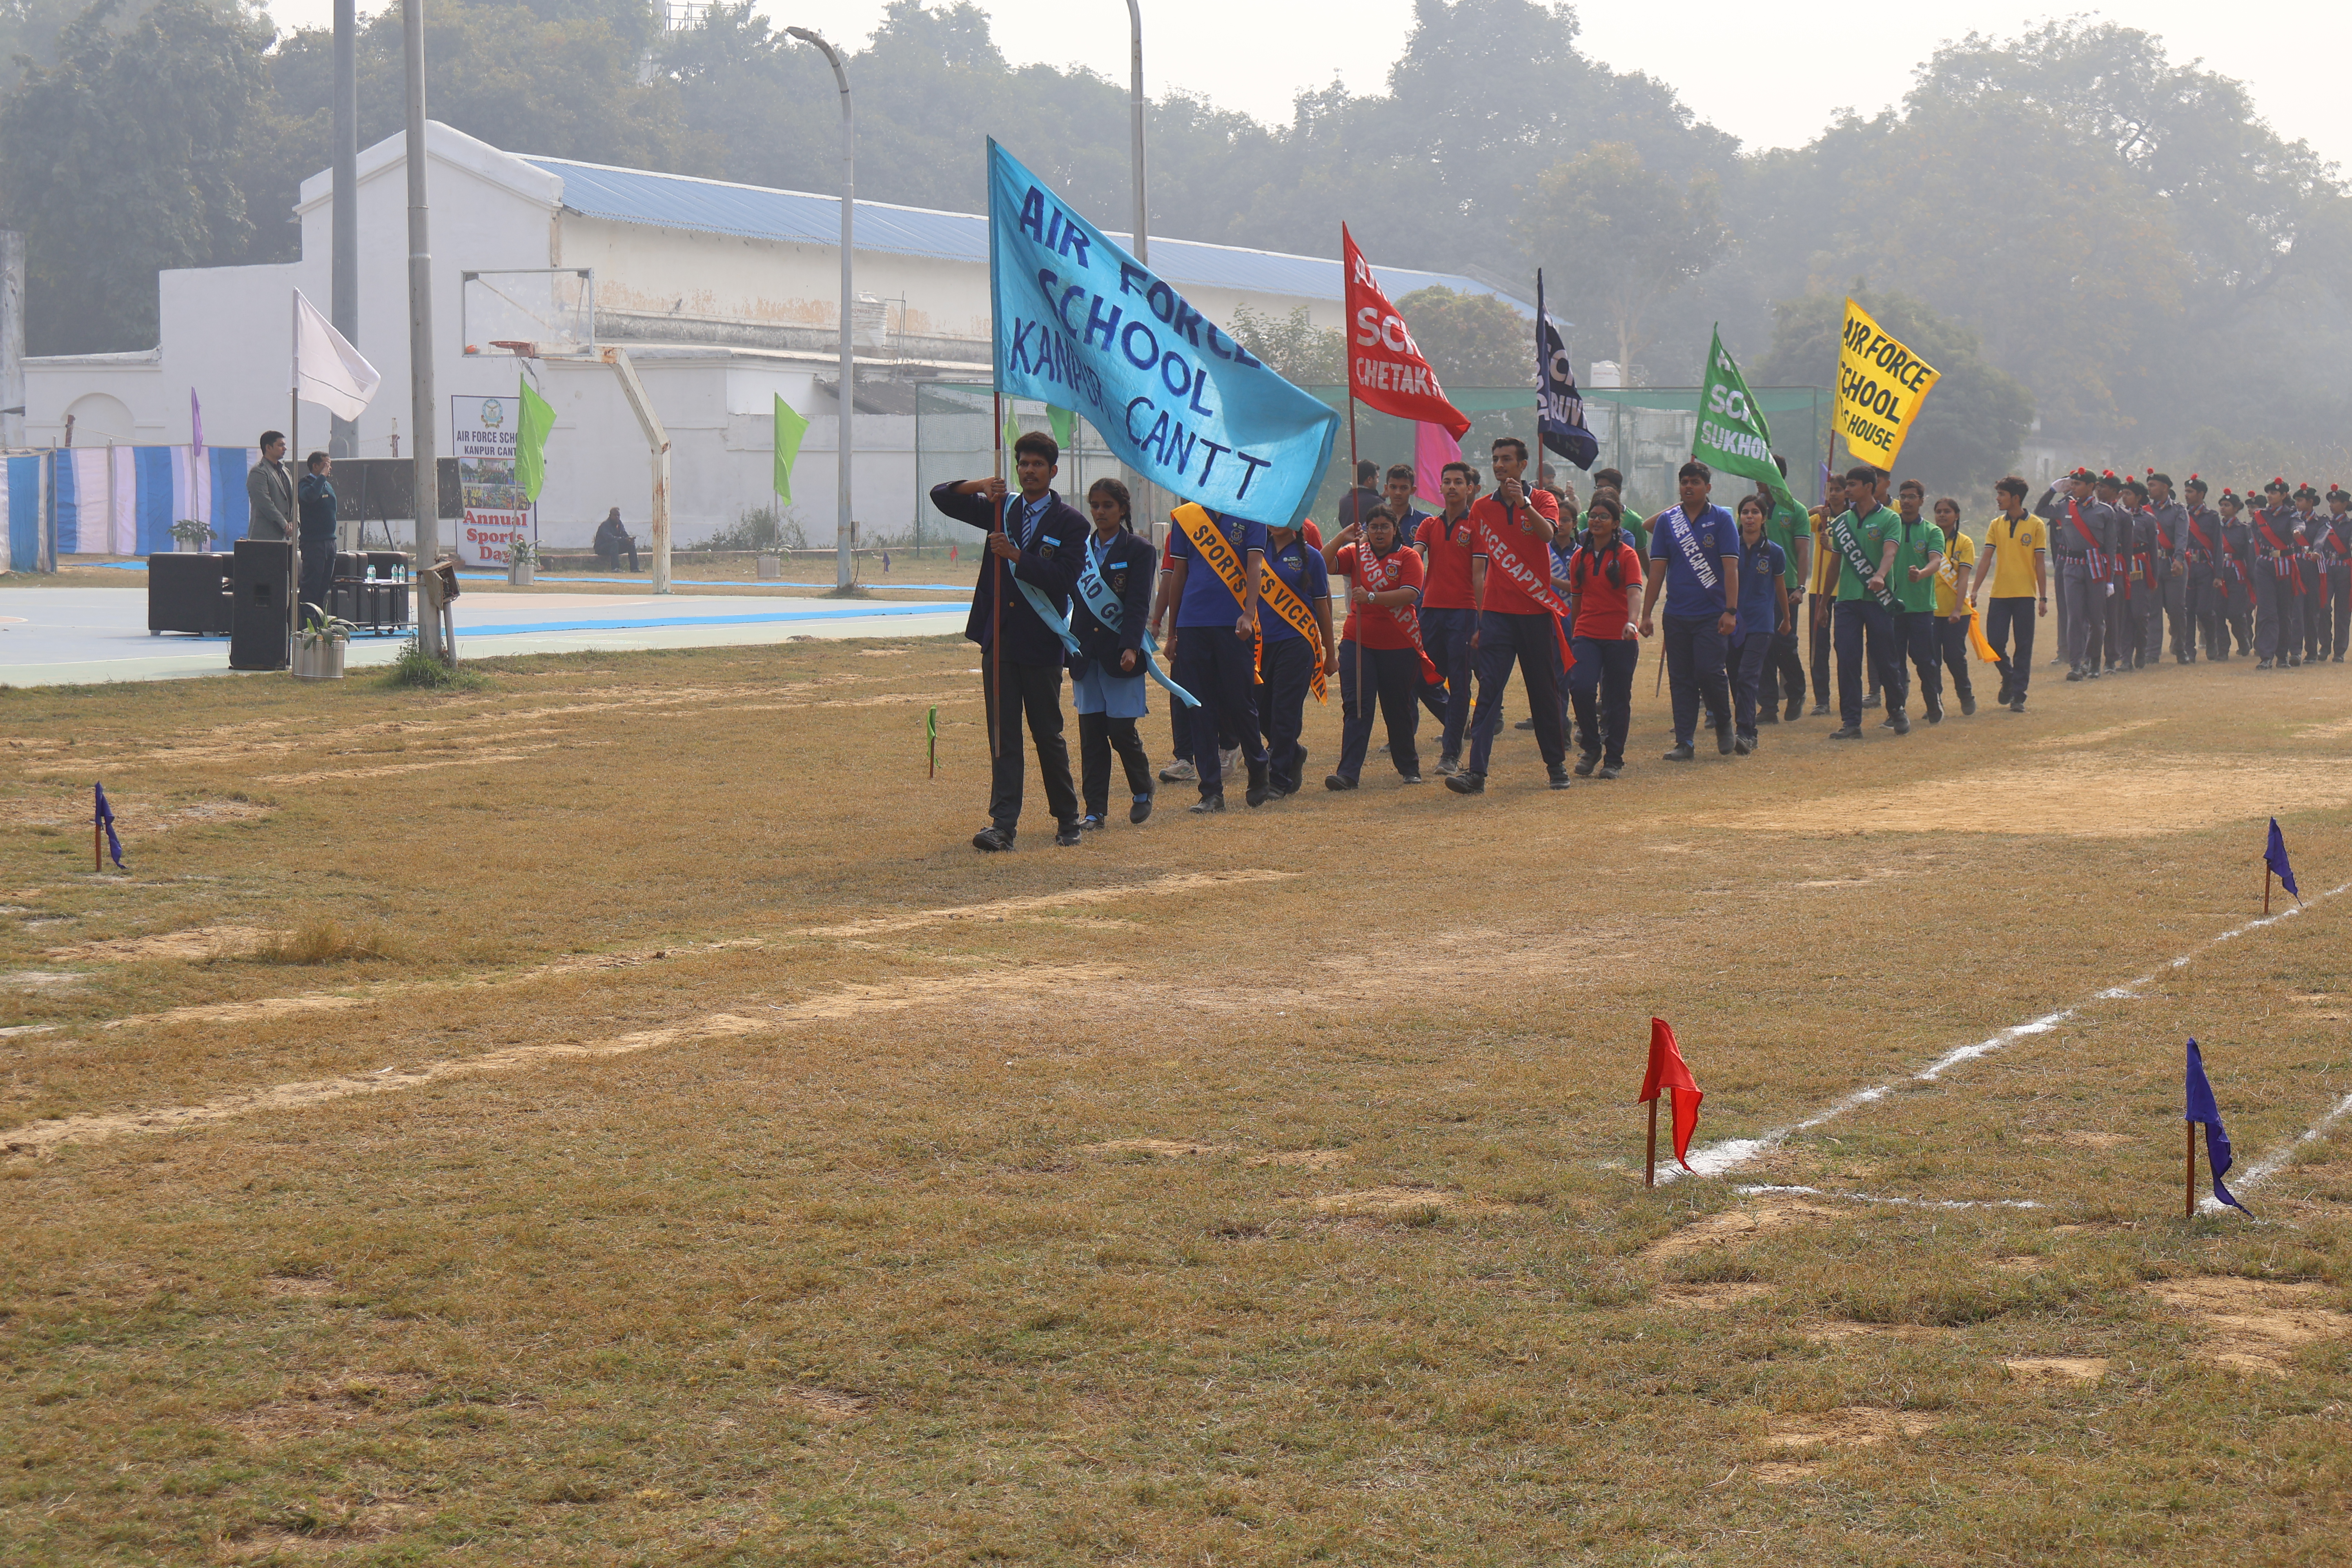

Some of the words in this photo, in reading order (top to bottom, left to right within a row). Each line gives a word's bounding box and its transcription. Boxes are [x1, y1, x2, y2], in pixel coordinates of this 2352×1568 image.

[1019, 185, 1091, 269] AIR
[1038, 268, 1212, 417] SCHOOL
[1844, 316, 1871, 356] AIR
[1864, 334, 1932, 394] FORCE
[1356, 357, 1432, 396] CHETAK
[1010, 318, 1114, 425] KANPUR
[1125, 396, 1272, 500] CANTT
[457, 430, 470, 442] AIR
[472, 431, 497, 443] FORCE
[465, 445, 495, 456] KANPUR
[1847, 414, 1895, 452] HOUSE
[463, 510, 528, 527] Annual
[466, 528, 524, 546] Sports
[1670, 509, 1690, 538] HOUSE
[1193, 524, 1246, 592] SPORTS
[1479, 519, 1508, 560] VICE
[1679, 533, 1700, 557] VICE
[1080, 554, 1103, 599] EAD
[1689, 553, 1718, 588] CAPTAIN
[1835, 519, 1856, 553] VICE
[1849, 549, 1893, 606] CAPIN
[1274, 588, 1312, 630] VICE
